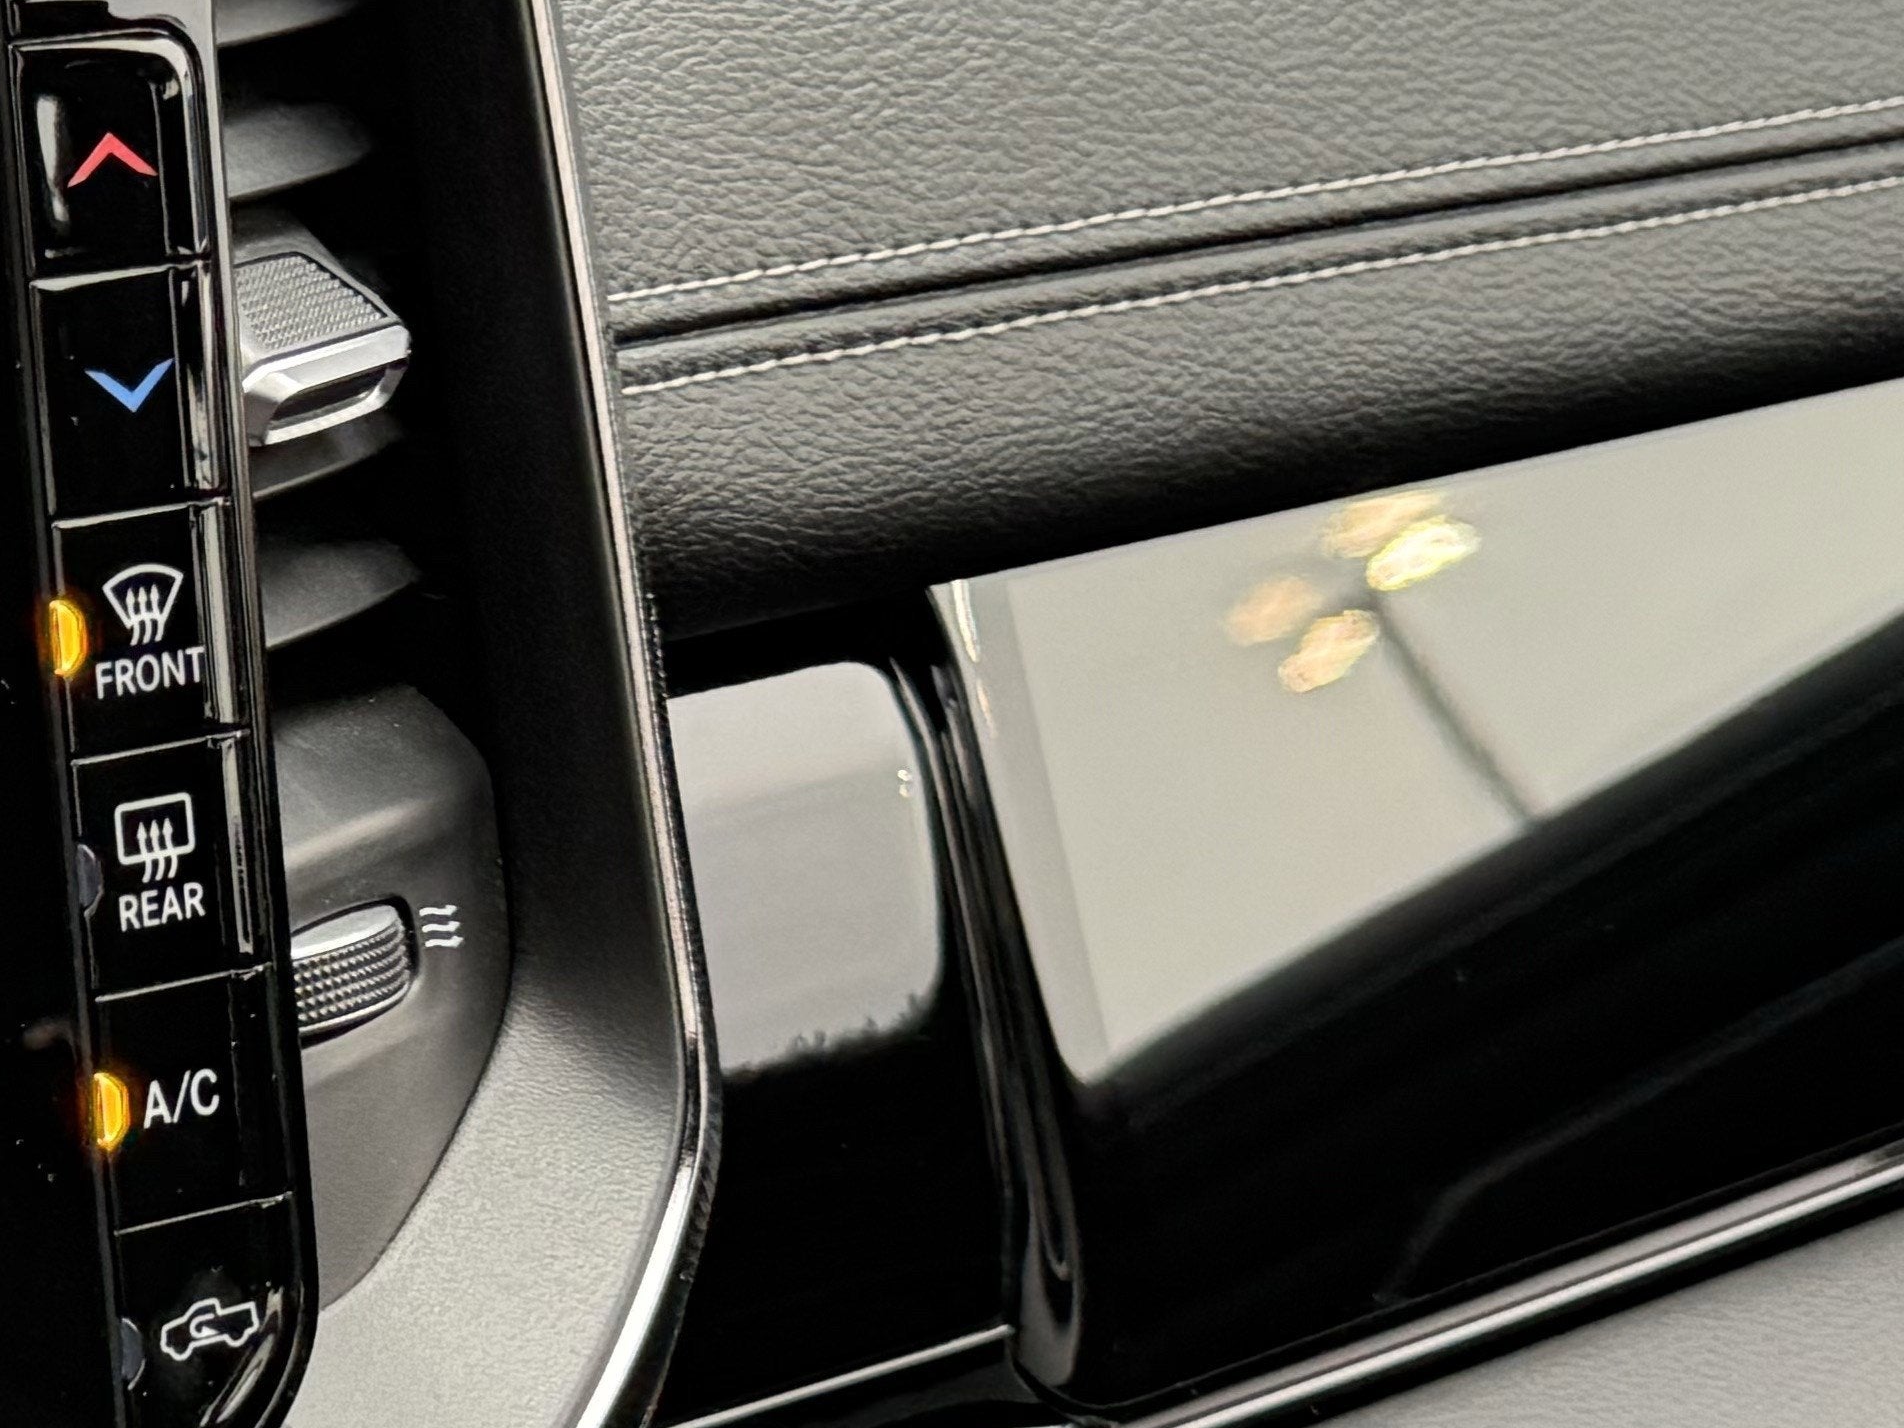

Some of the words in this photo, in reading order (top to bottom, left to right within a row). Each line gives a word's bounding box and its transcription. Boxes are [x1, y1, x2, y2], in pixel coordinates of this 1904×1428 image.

[95, 646, 205, 700] FRONT
[118, 882, 206, 933] REAR
[143, 1068, 220, 1129] A/C
